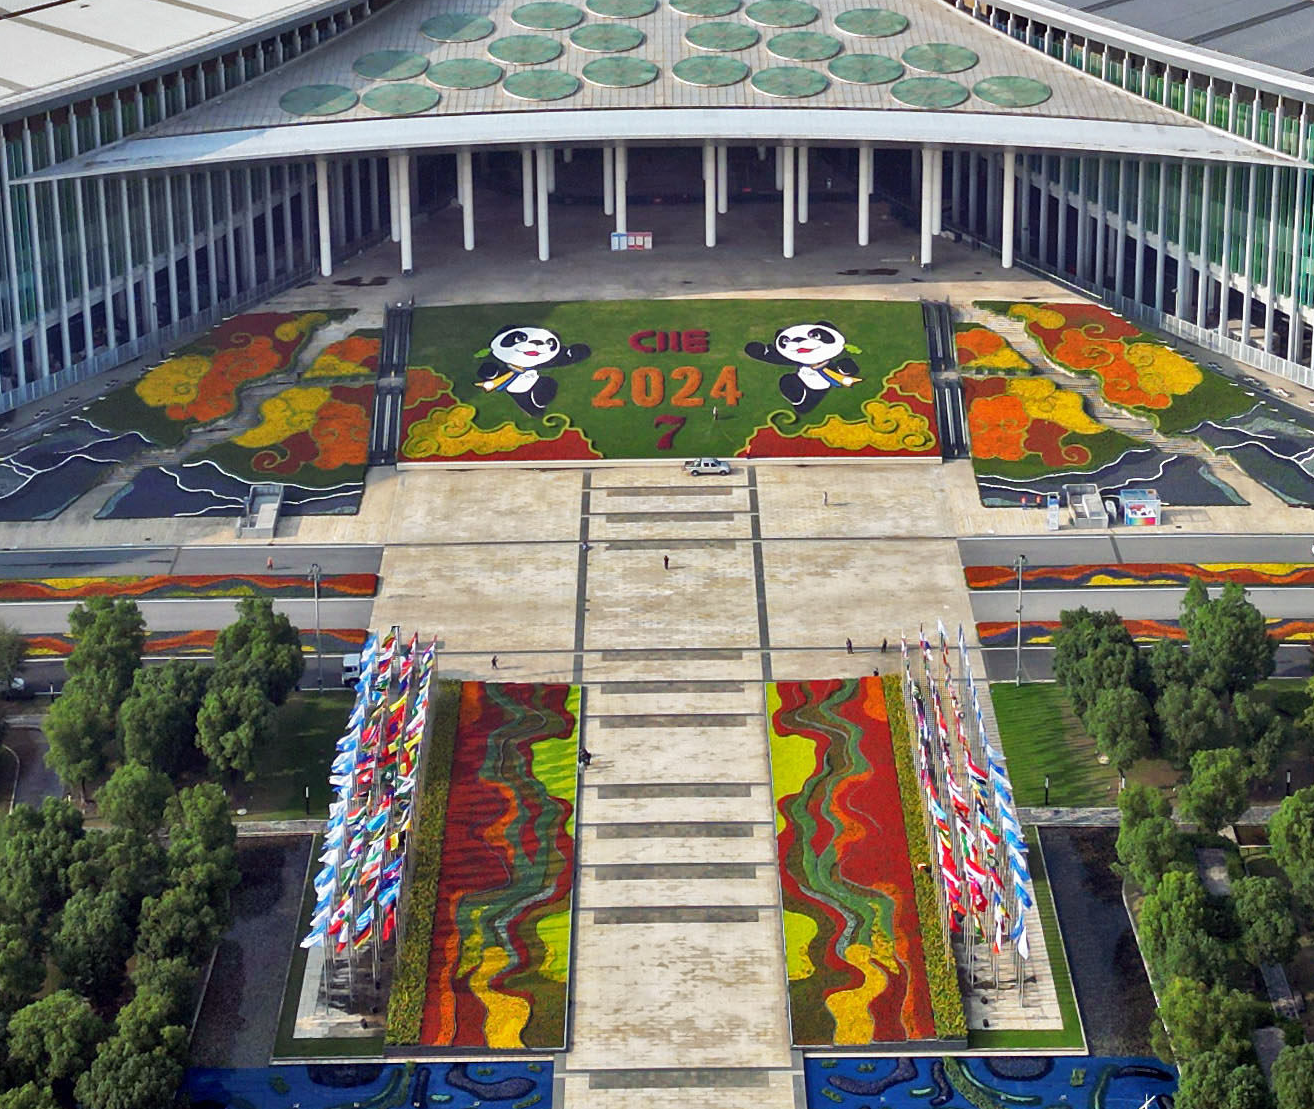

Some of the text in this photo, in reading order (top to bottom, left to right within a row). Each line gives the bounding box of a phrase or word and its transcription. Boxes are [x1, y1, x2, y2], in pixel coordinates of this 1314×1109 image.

[628, 329, 710, 354] CIIE
[590, 365, 744, 408] 2024
[653, 414, 686, 450] 7
